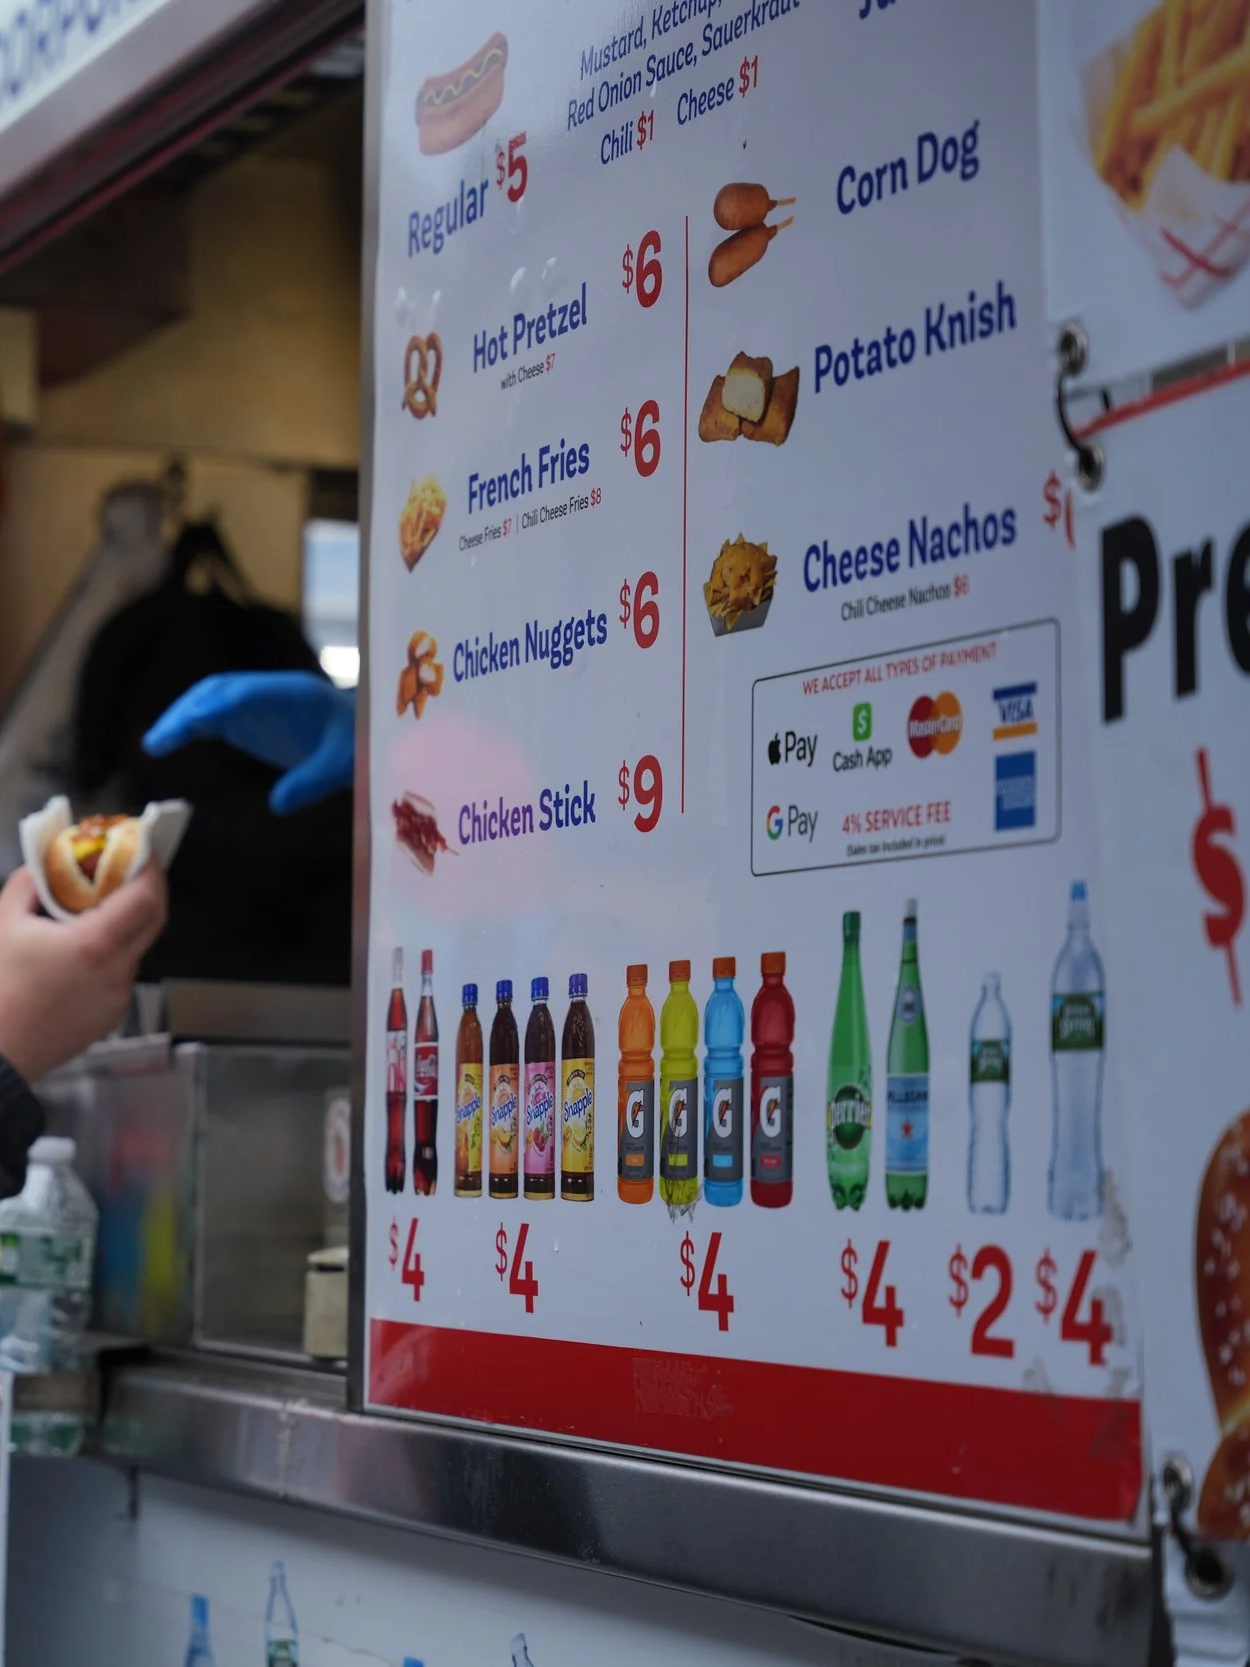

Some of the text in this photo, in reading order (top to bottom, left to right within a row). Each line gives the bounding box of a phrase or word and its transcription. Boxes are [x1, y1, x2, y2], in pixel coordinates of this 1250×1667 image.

[580, 0, 722, 80] Mustard, Ketchup,
[568, 87, 594, 131] Red
[599, 70, 642, 113] Onion
[646, 41, 697, 87] Sauce,
[600, 55, 759, 165] Chili $1 Cheese $1
[495, 131, 528, 203] $5
[836, 120, 981, 215] Corn Dog
[407, 178, 490, 259] Regular
[621, 230, 663, 308] $6
[472, 282, 588, 374] Hot Pretzel
[814, 281, 1017, 394] Potato Knish
[501, 352, 556, 390] with Cheese $7
[468, 438, 590, 514] French Fries
[620, 400, 662, 478] $6
[459, 532, 483, 551] Cheese
[484, 525, 501, 542] Fries
[502, 518, 513, 536] $7
[539, 502, 568, 524] Cheese
[569, 494, 589, 514] Fries
[590, 487, 602, 508] $8
[803, 502, 1017, 592] Cheese Nachos
[619, 571, 661, 649] $6
[841, 599, 865, 621] Chili
[865, 594, 907, 616] Cheese
[908, 582, 951, 605] Nachos
[453, 609, 608, 682] Chicken Nuggets
[803, 642, 997, 696] WE ACCEPT ALL TYPES OF PAYMENT
[999, 697, 1034, 723] VISA
[785, 731, 818, 768] Pay
[833, 745, 893, 773] Cash App
[458, 780, 596, 846] Chicken Stick
[618, 754, 663, 833] $9
[787, 804, 819, 844] Pay
[842, 799, 952, 835] 4% SERVICE FEE
[456, 1092, 481, 1124] Snapple
[491, 1092, 517, 1126] Snapple
[526, 1091, 554, 1126] Snapple
[563, 1088, 593, 1123] Snapple
[388, 1216, 425, 1302] $4
[494, 1222, 539, 1314] $4
[680, 1230, 735, 1332] $4
[840, 1238, 905, 1348] $4
[947, 1243, 1015, 1359] $2
[1035, 1246, 1113, 1367] $4
